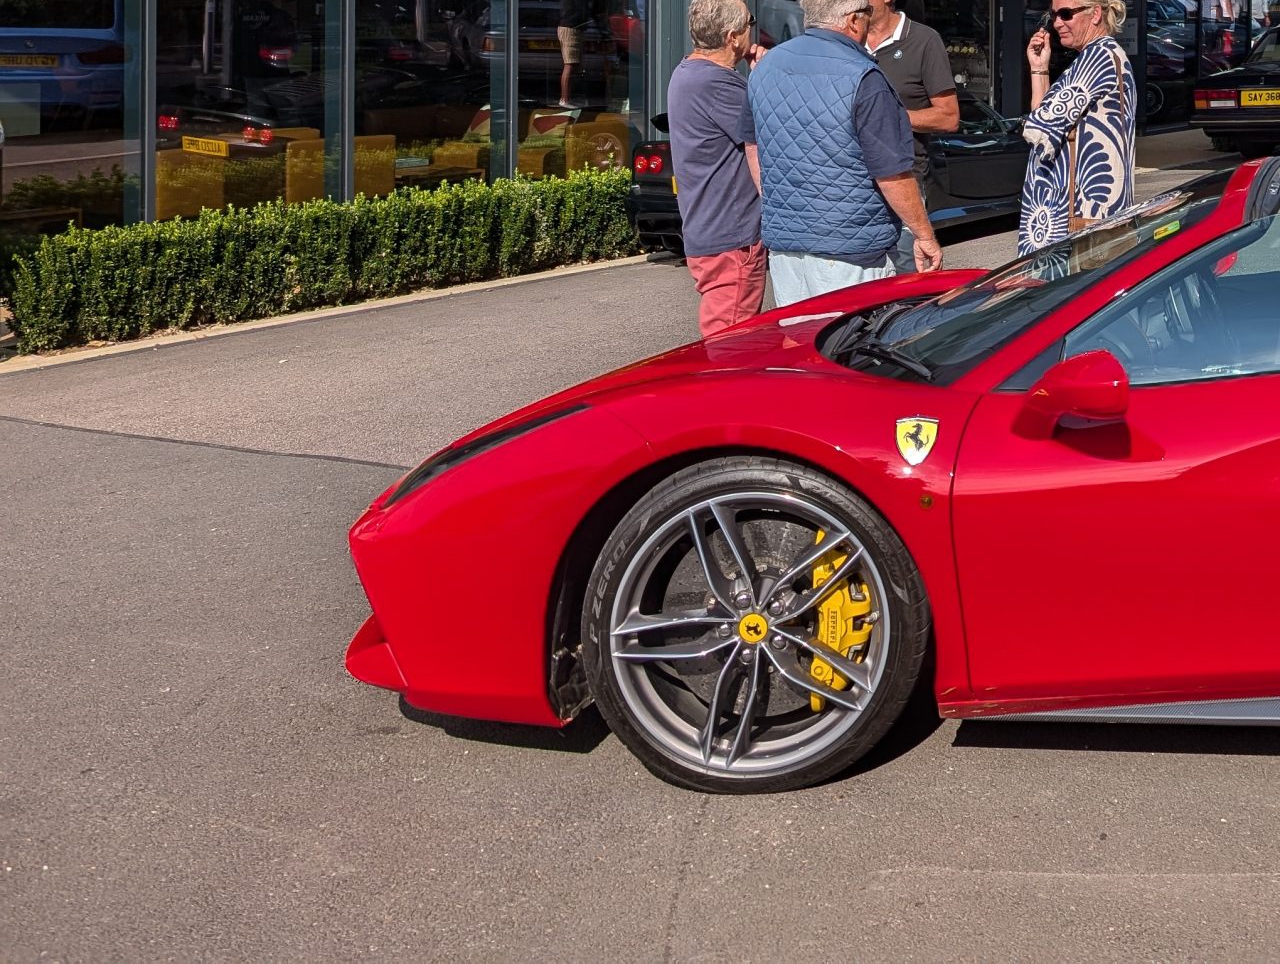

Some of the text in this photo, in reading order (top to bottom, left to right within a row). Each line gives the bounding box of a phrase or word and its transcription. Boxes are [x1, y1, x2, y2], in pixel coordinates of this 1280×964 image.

[1247, 92, 1280, 102] SAY 368
[589, 539, 626, 645] P ZERO
